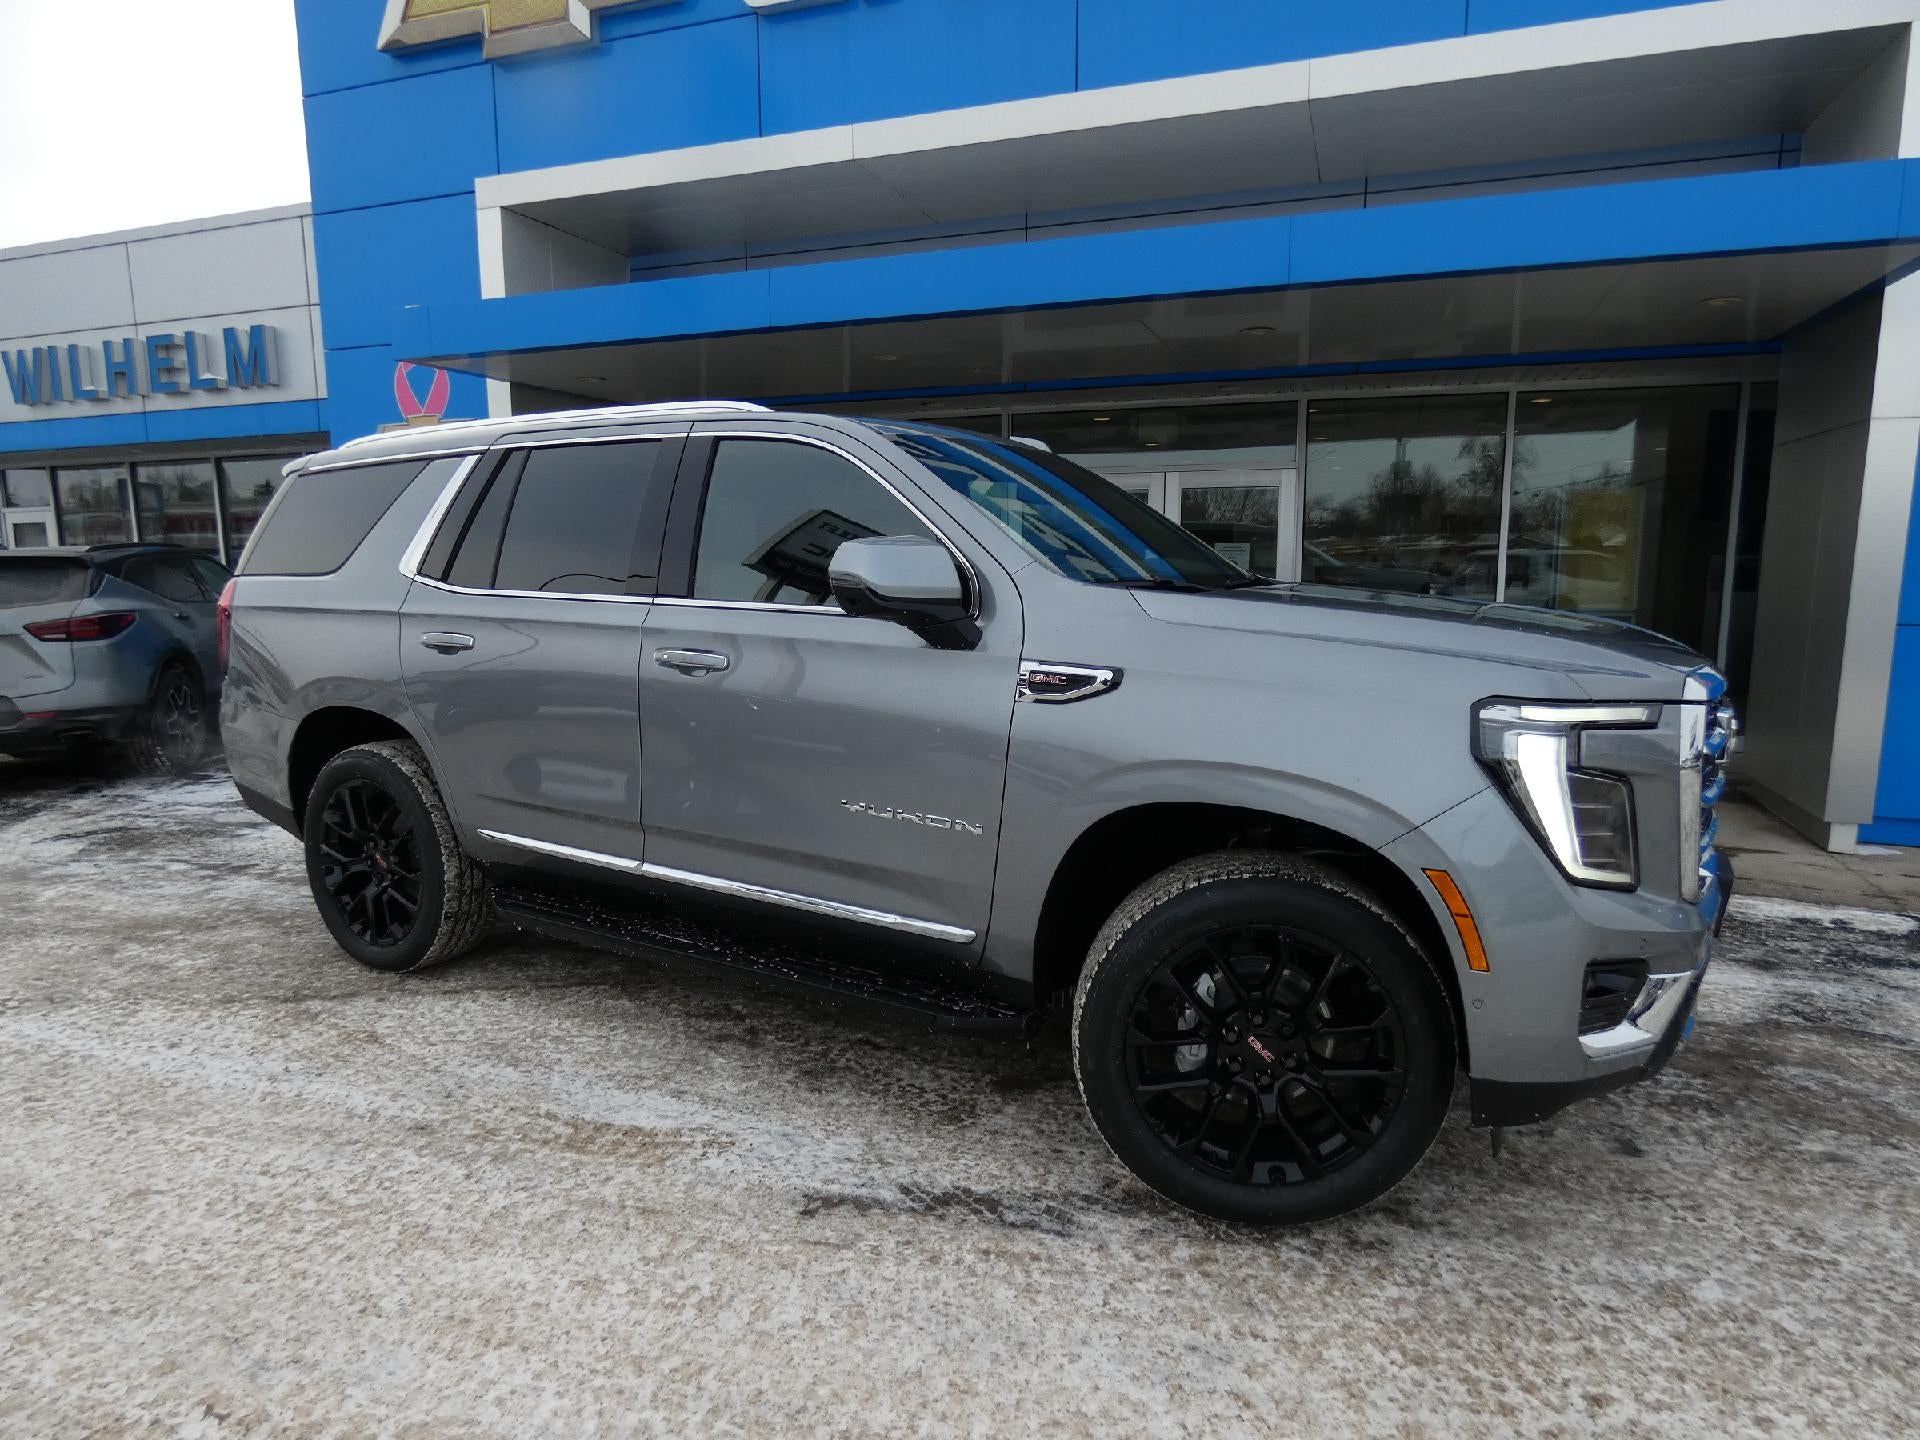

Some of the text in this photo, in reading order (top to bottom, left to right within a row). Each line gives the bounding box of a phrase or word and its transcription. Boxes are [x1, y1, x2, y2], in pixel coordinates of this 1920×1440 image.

[1, 324, 276, 405] WILHELM
[1029, 673, 1067, 685] GMC
[841, 799, 983, 836] YUKON
[1247, 1036, 1275, 1063] GMC
